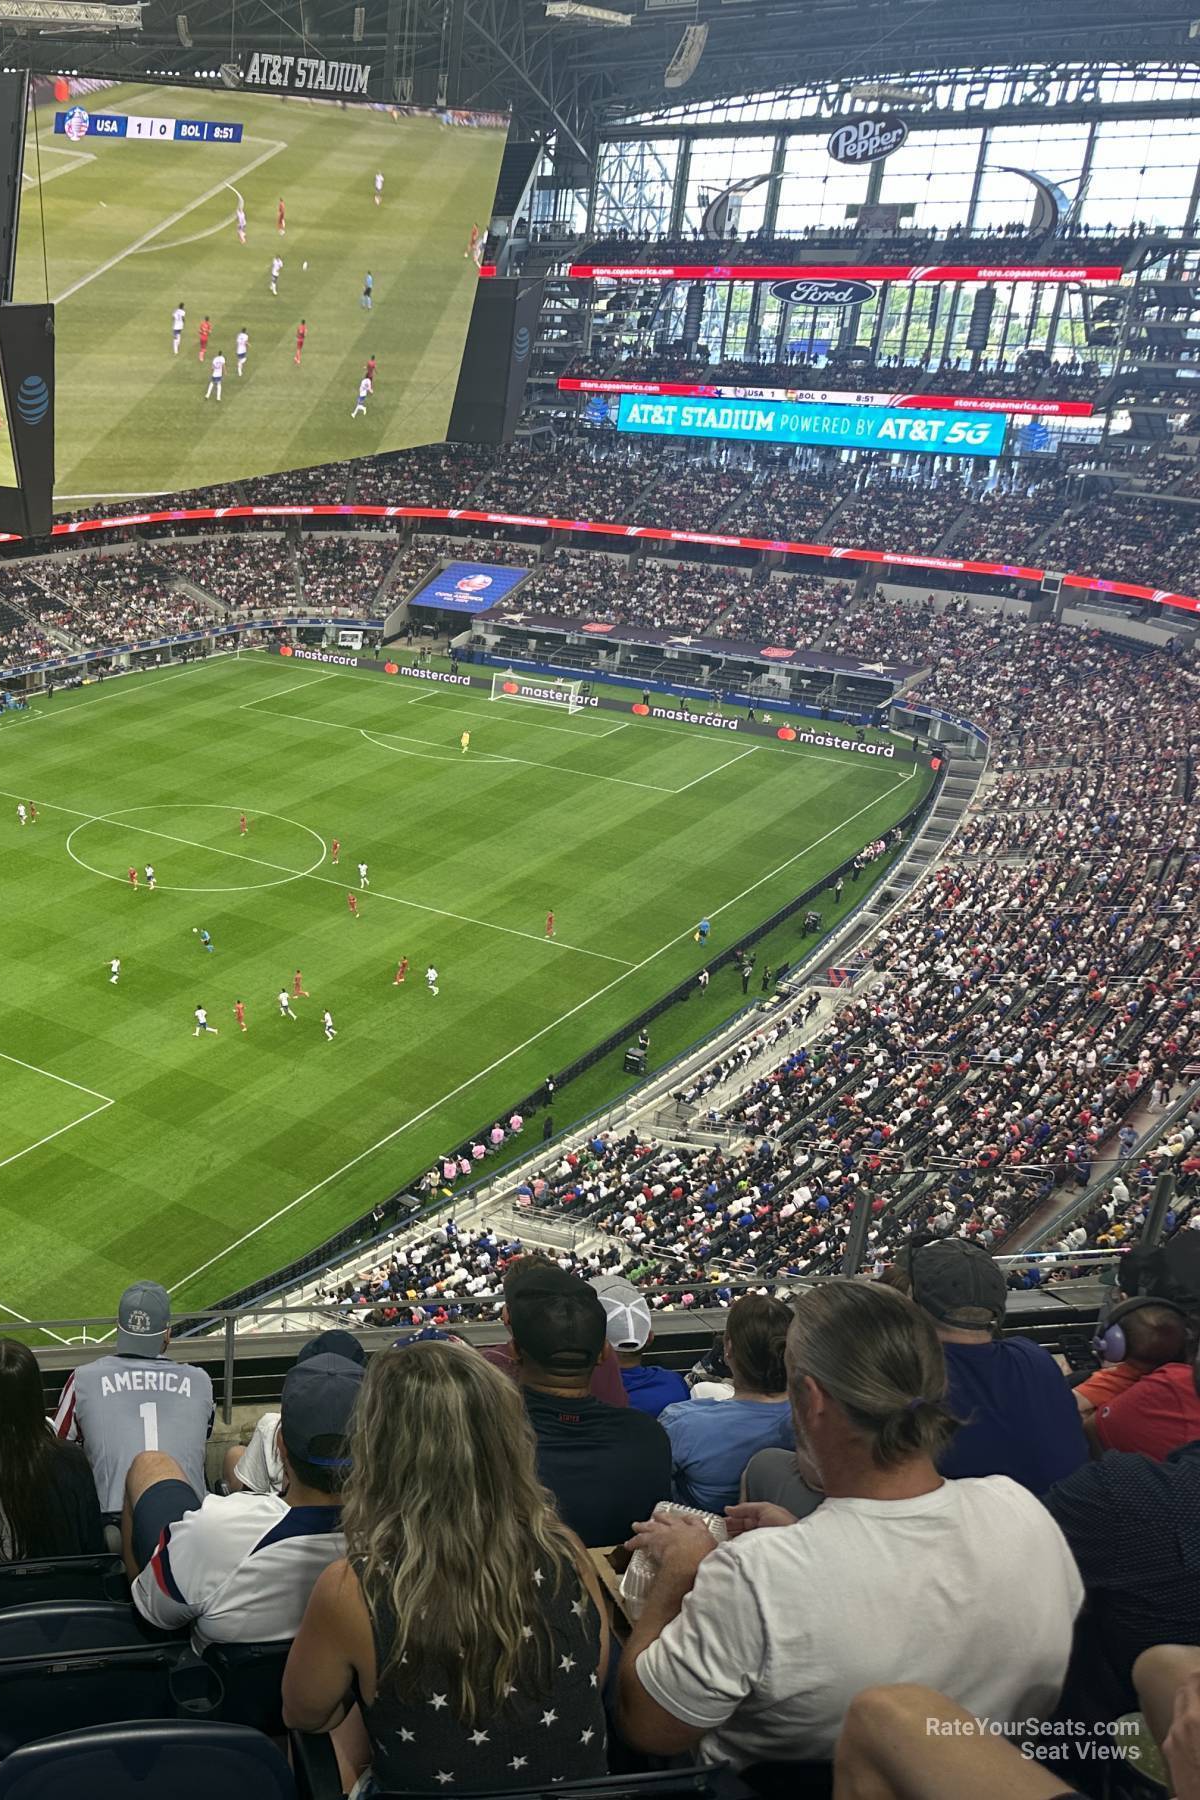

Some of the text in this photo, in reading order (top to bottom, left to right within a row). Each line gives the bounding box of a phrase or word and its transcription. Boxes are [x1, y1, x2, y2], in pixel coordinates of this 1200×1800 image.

[245, 52, 371, 94] AT&T STADIUM
[96, 120, 234, 138] USA 1 0 BOL 8:51
[858, 120, 886, 140] Dr
[831, 125, 903, 159] Pepper
[592, 267, 674, 277] store.copaamerica.com
[977, 268, 1087, 278] store.copaamerica.com
[790, 281, 854, 302] Ford
[748, 390, 764, 398] USA
[798, 392, 816, 400] BOL
[855, 394, 874, 402] 8:51
[953, 399, 1060, 412] store.copaamerica.com
[626, 403, 992, 445] AT&T STADIUM POWERED BY AT&T 5G
[294, 648, 358, 667] mastercard
[400, 665, 471, 686] mastercard
[521, 685, 599, 707] mastercard
[652, 706, 738, 730] mastercard
[799, 732, 895, 758] mastercard
[101, 1370, 191, 1398] AMERICA
[139, 1402, 159, 1451] 1
